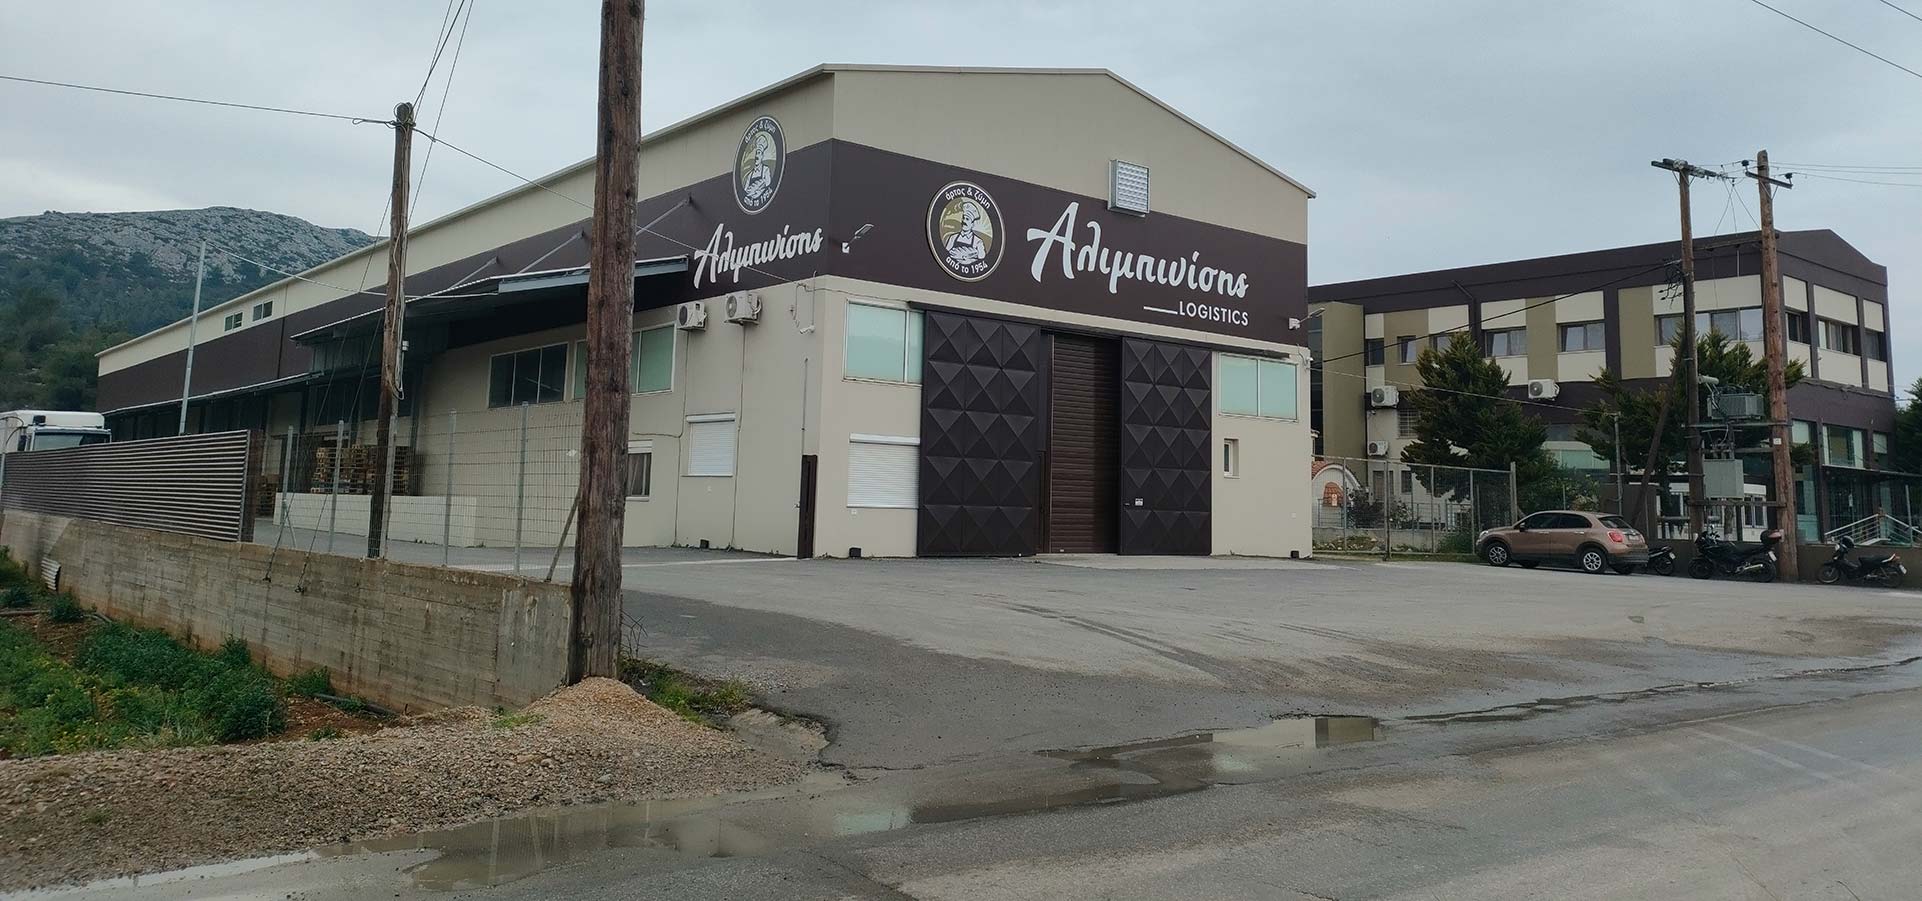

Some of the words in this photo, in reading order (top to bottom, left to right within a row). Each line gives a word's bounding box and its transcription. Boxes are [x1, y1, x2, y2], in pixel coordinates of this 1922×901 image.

[945, 188, 966, 201] άρτος
[966, 187, 973, 197] &
[974, 189, 991, 209] ζύμη
[945, 256, 960, 271] από
[961, 265, 970, 274] το
[971, 260, 988, 274] 1954
[1179, 300, 1249, 327] LOGISTICS
